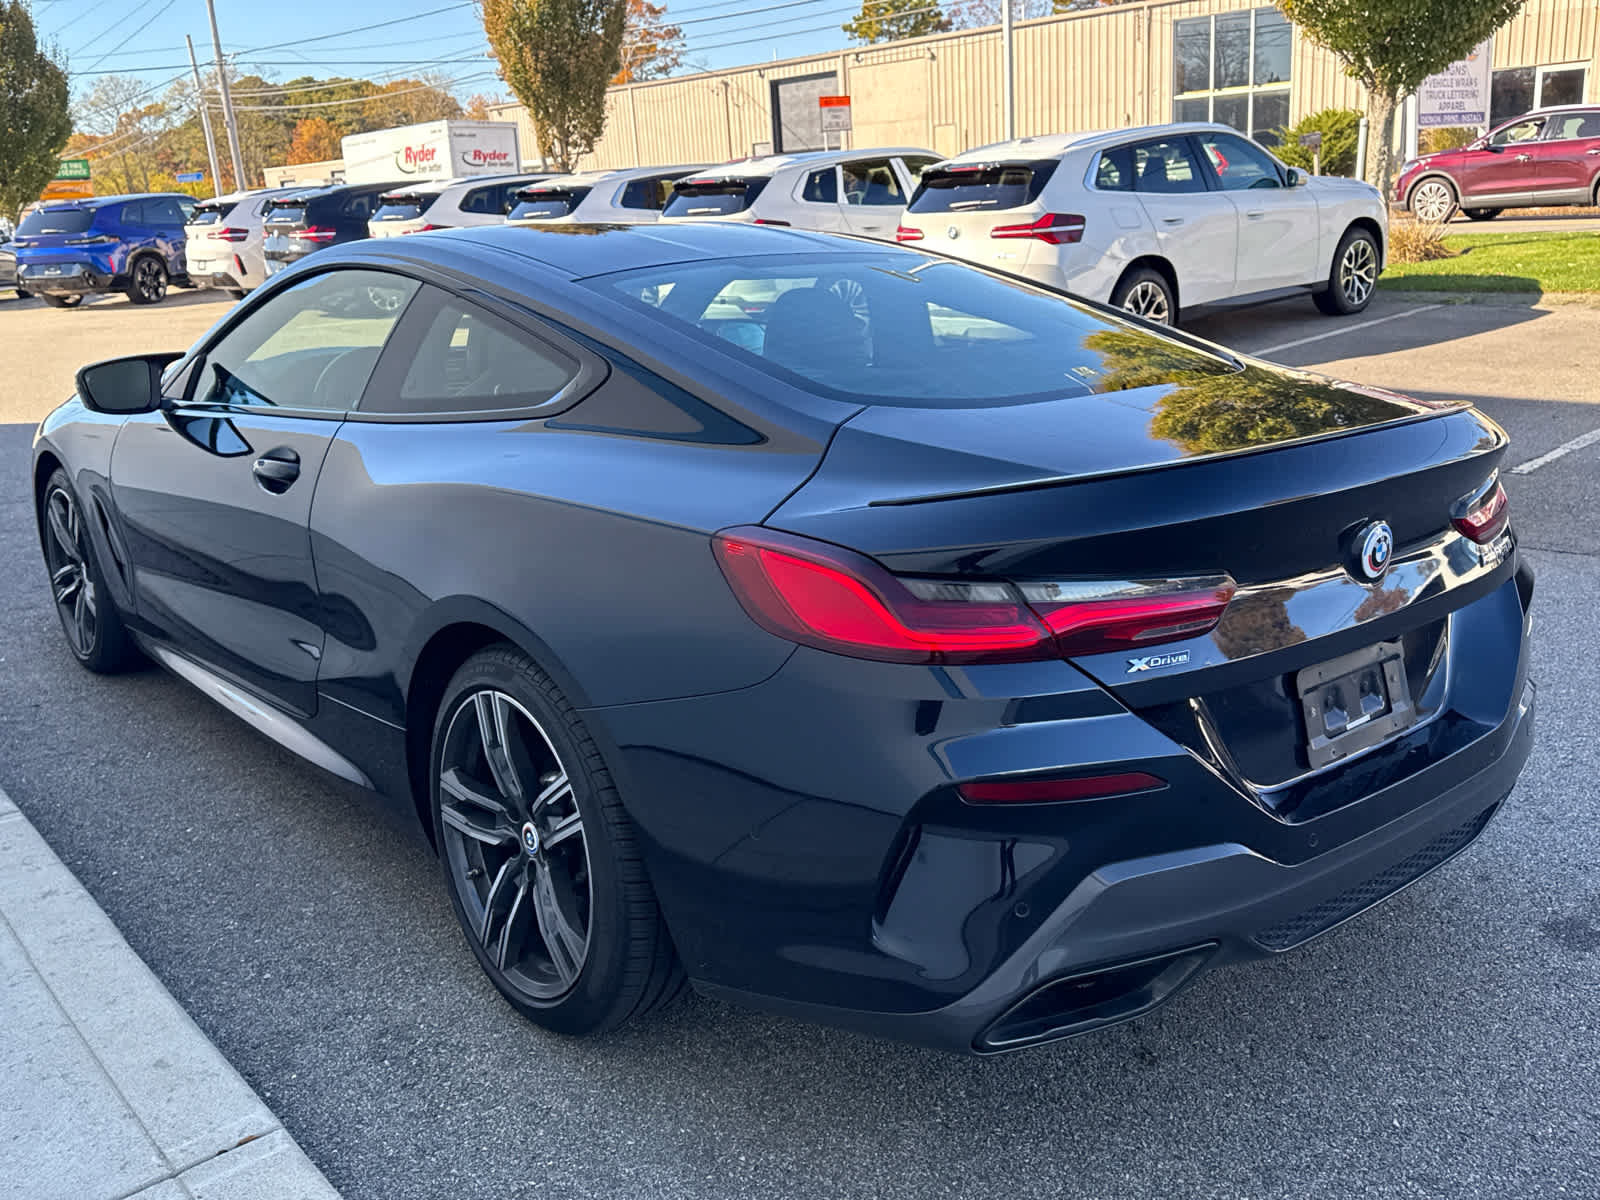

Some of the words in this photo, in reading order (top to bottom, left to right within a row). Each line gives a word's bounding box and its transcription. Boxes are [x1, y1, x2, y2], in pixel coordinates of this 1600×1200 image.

[1438, 101, 1466, 111] APPAREL
[405, 144, 437, 167] Ryder
[472, 149, 509, 164] Ryder
